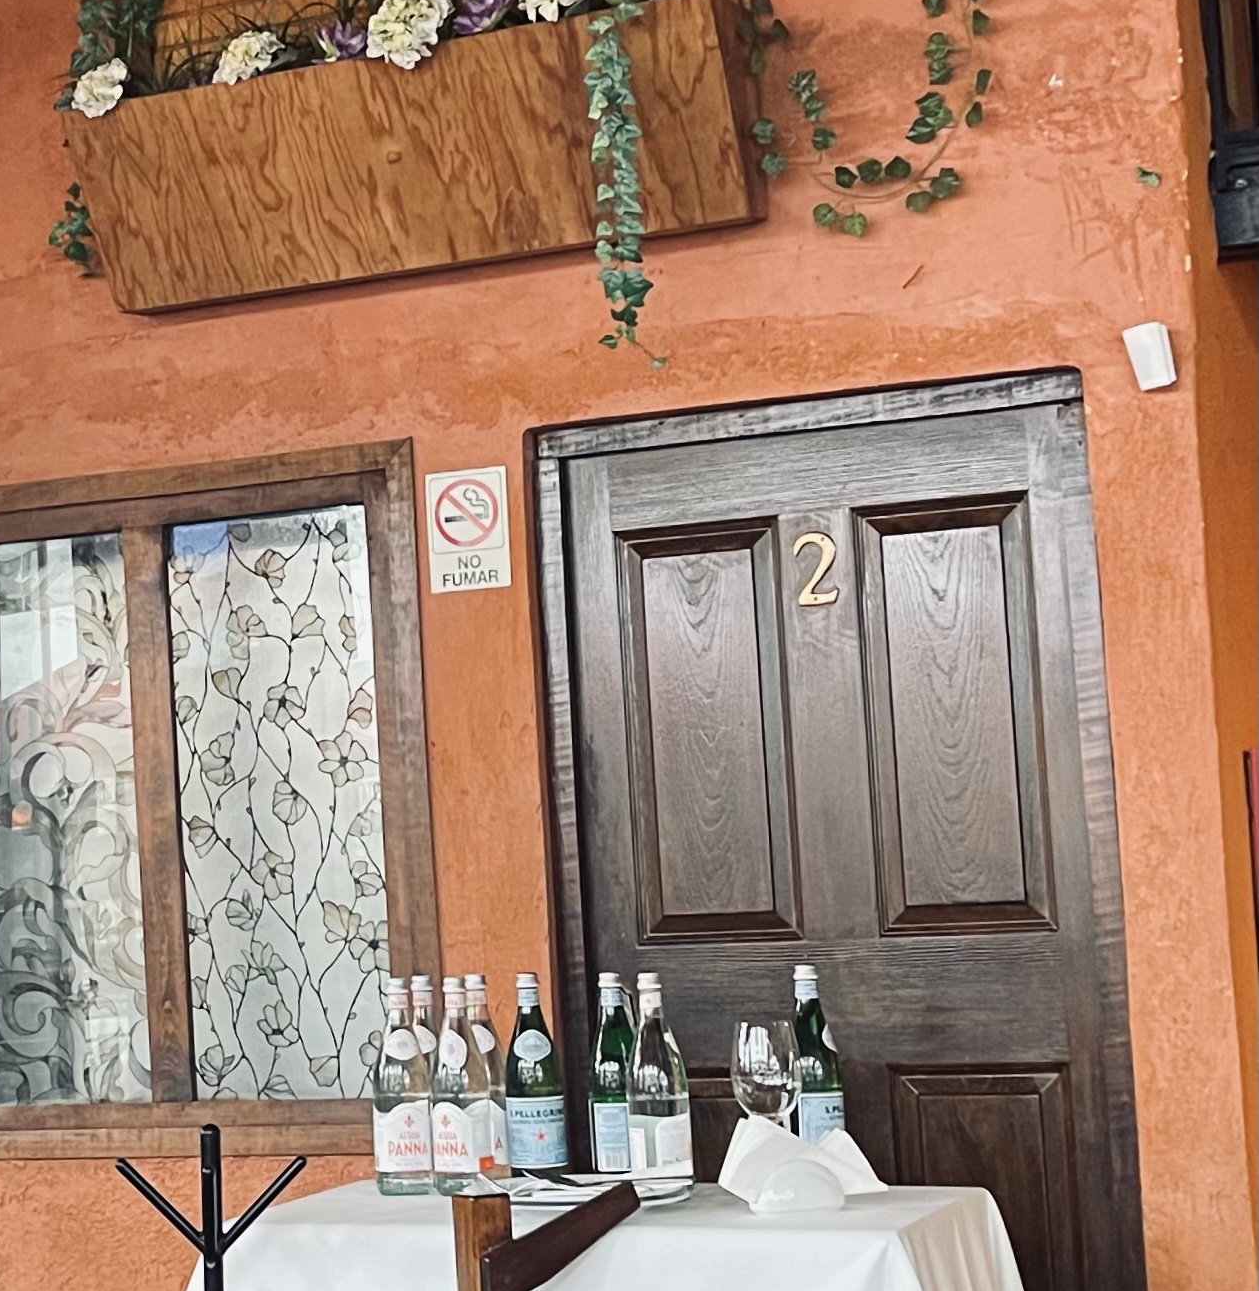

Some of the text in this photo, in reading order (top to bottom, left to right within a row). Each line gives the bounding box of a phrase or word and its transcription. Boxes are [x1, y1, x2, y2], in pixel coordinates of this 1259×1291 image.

[457, 555, 482, 569] NO
[793, 531, 840, 607] 2
[442, 569, 499, 588] FUMAR
[388, 1140, 429, 1157] PANNA
